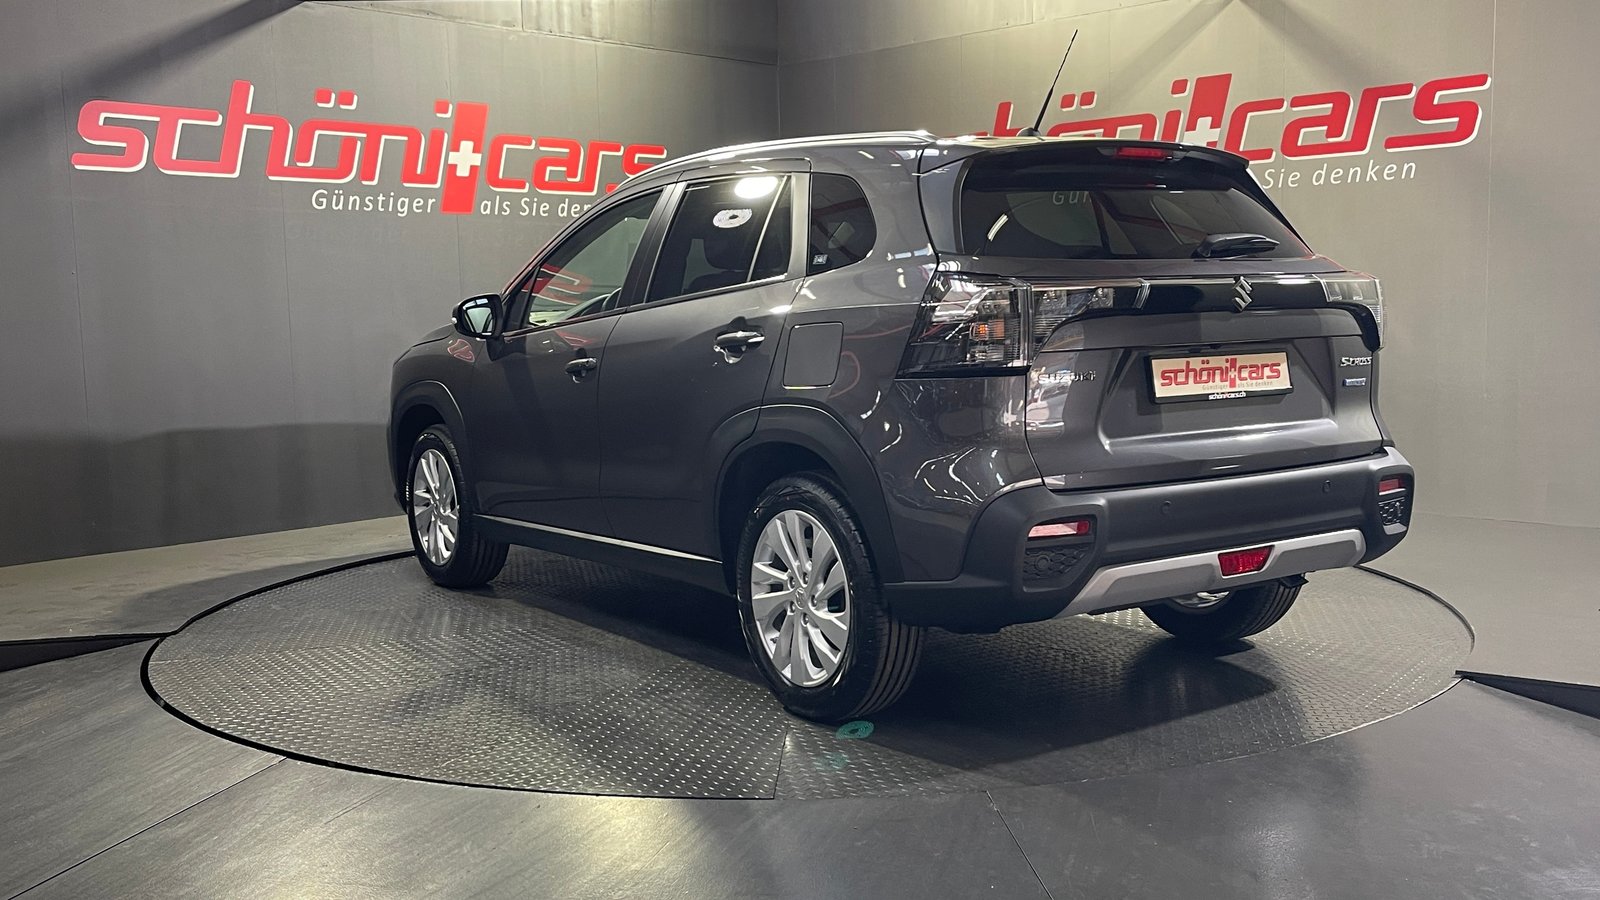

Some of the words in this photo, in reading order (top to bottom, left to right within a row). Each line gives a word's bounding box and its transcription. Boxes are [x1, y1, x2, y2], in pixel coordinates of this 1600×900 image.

[1263, 168, 1301, 189] Sie
[1312, 160, 1417, 186] denken
[311, 189, 436, 217] Günstiger
[480, 195, 511, 216] als
[520, 197, 550, 217] Sie
